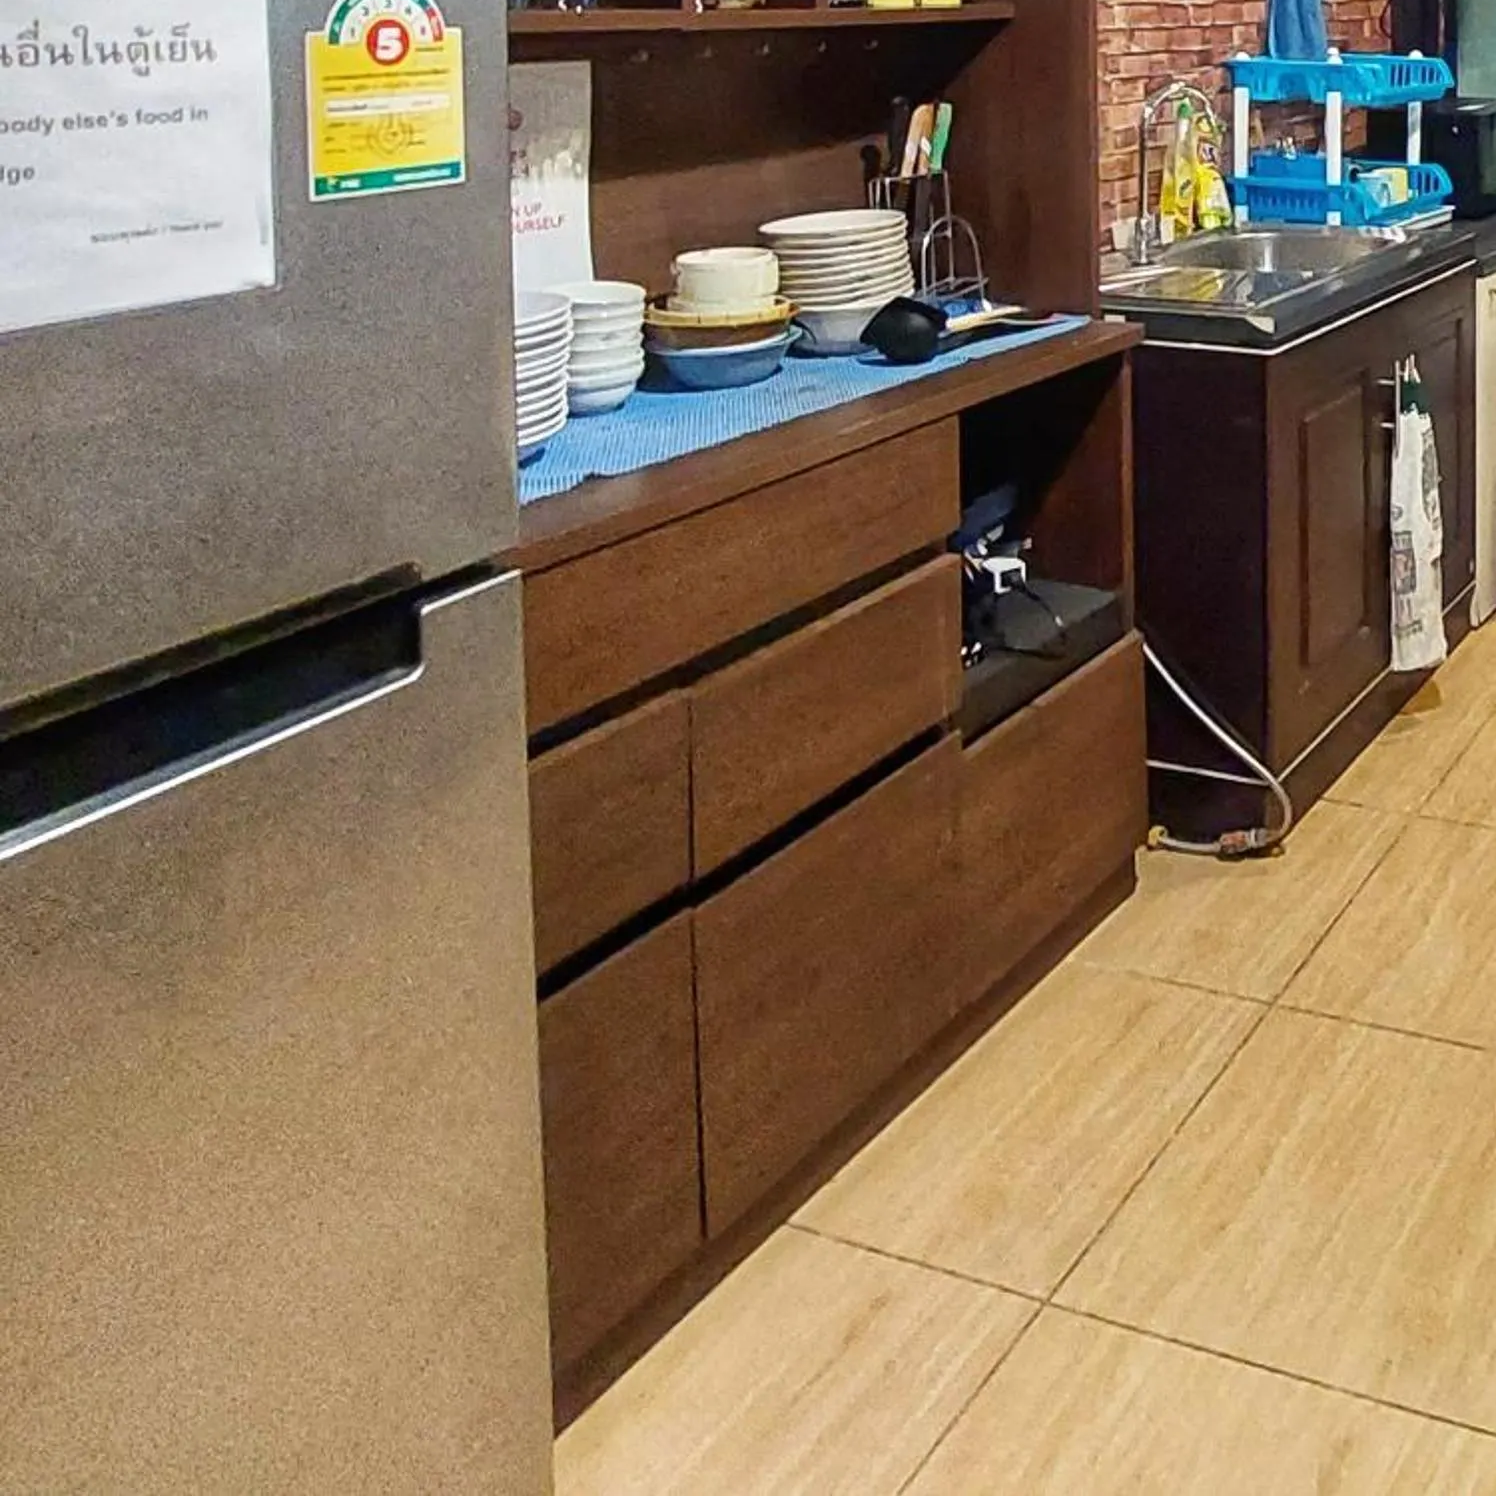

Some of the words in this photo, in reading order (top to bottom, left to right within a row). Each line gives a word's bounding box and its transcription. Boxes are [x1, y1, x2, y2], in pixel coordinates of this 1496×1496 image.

[376, 27, 404, 60] 5
[62, 110, 129, 131] else's
[135, 107, 184, 125] food
[190, 103, 208, 121] in
